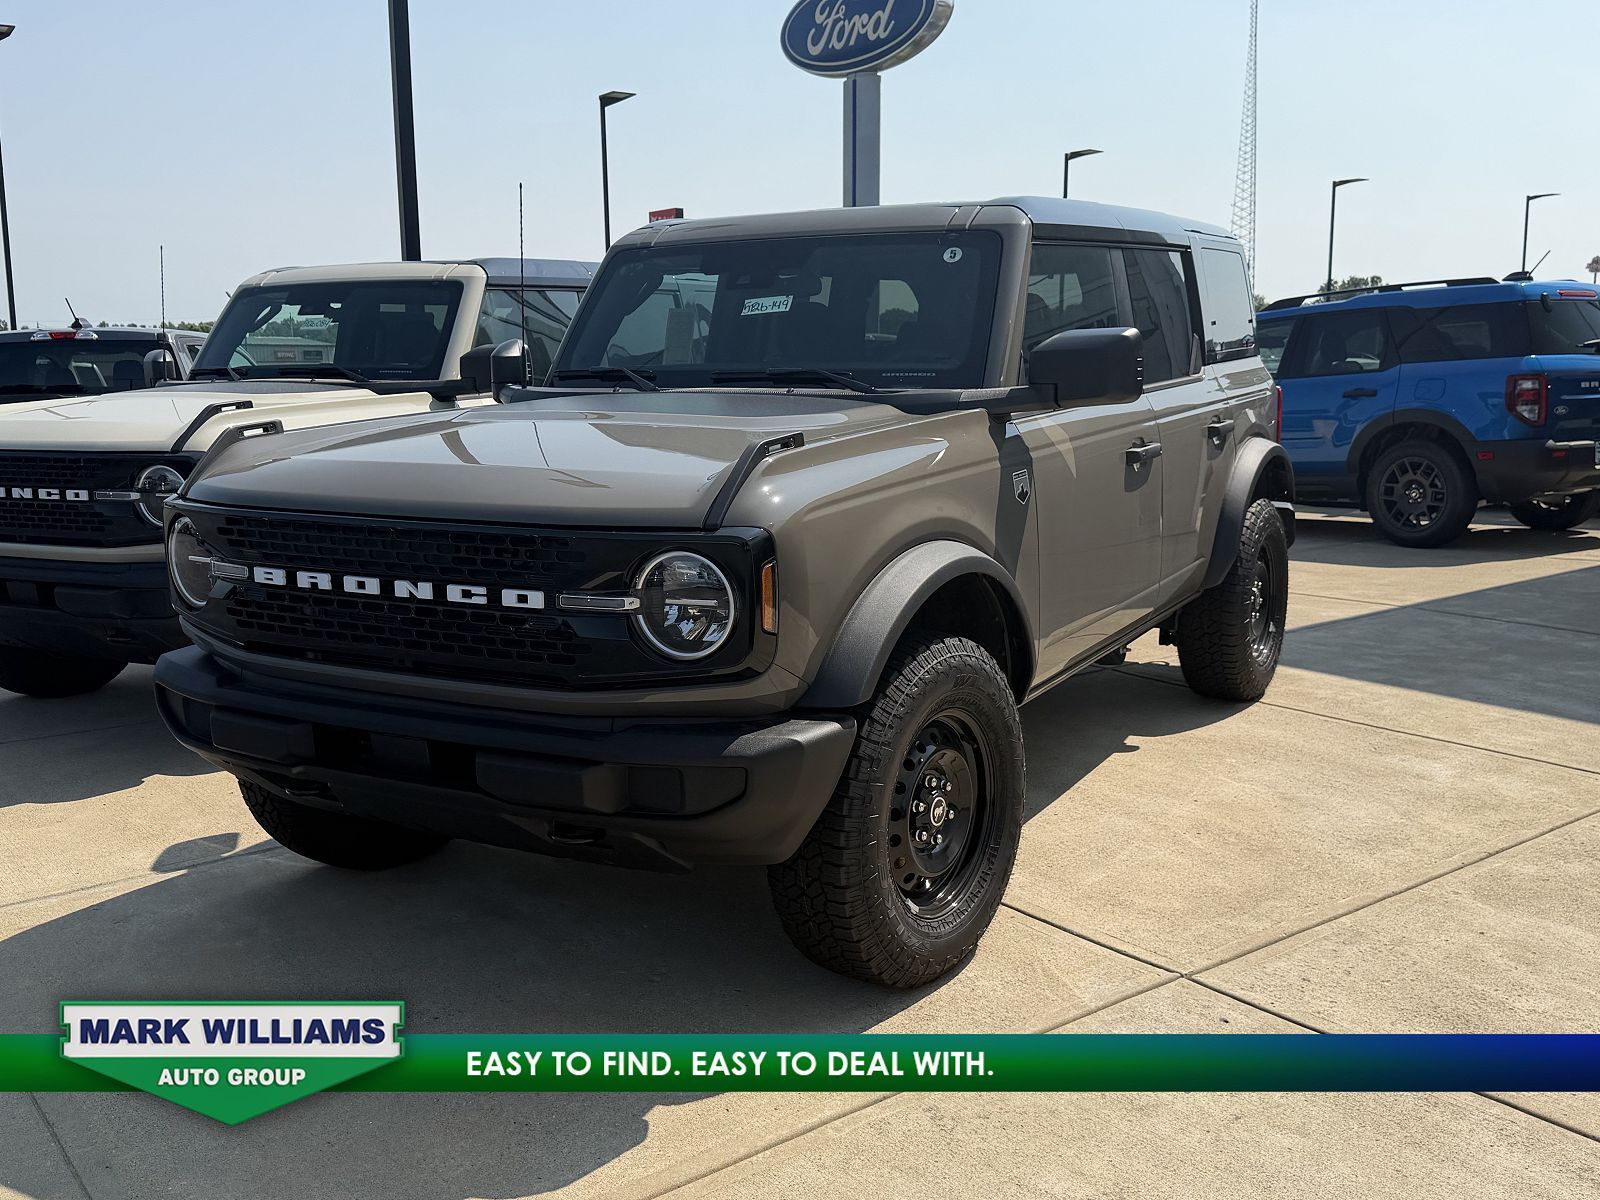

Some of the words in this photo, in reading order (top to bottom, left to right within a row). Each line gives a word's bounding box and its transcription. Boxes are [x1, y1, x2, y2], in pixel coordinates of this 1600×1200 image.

[807, 0, 895, 56] Ford
[950, 249, 957, 259] 5
[0, 486, 89, 501] NCO
[253, 566, 545, 609] BRONCO
